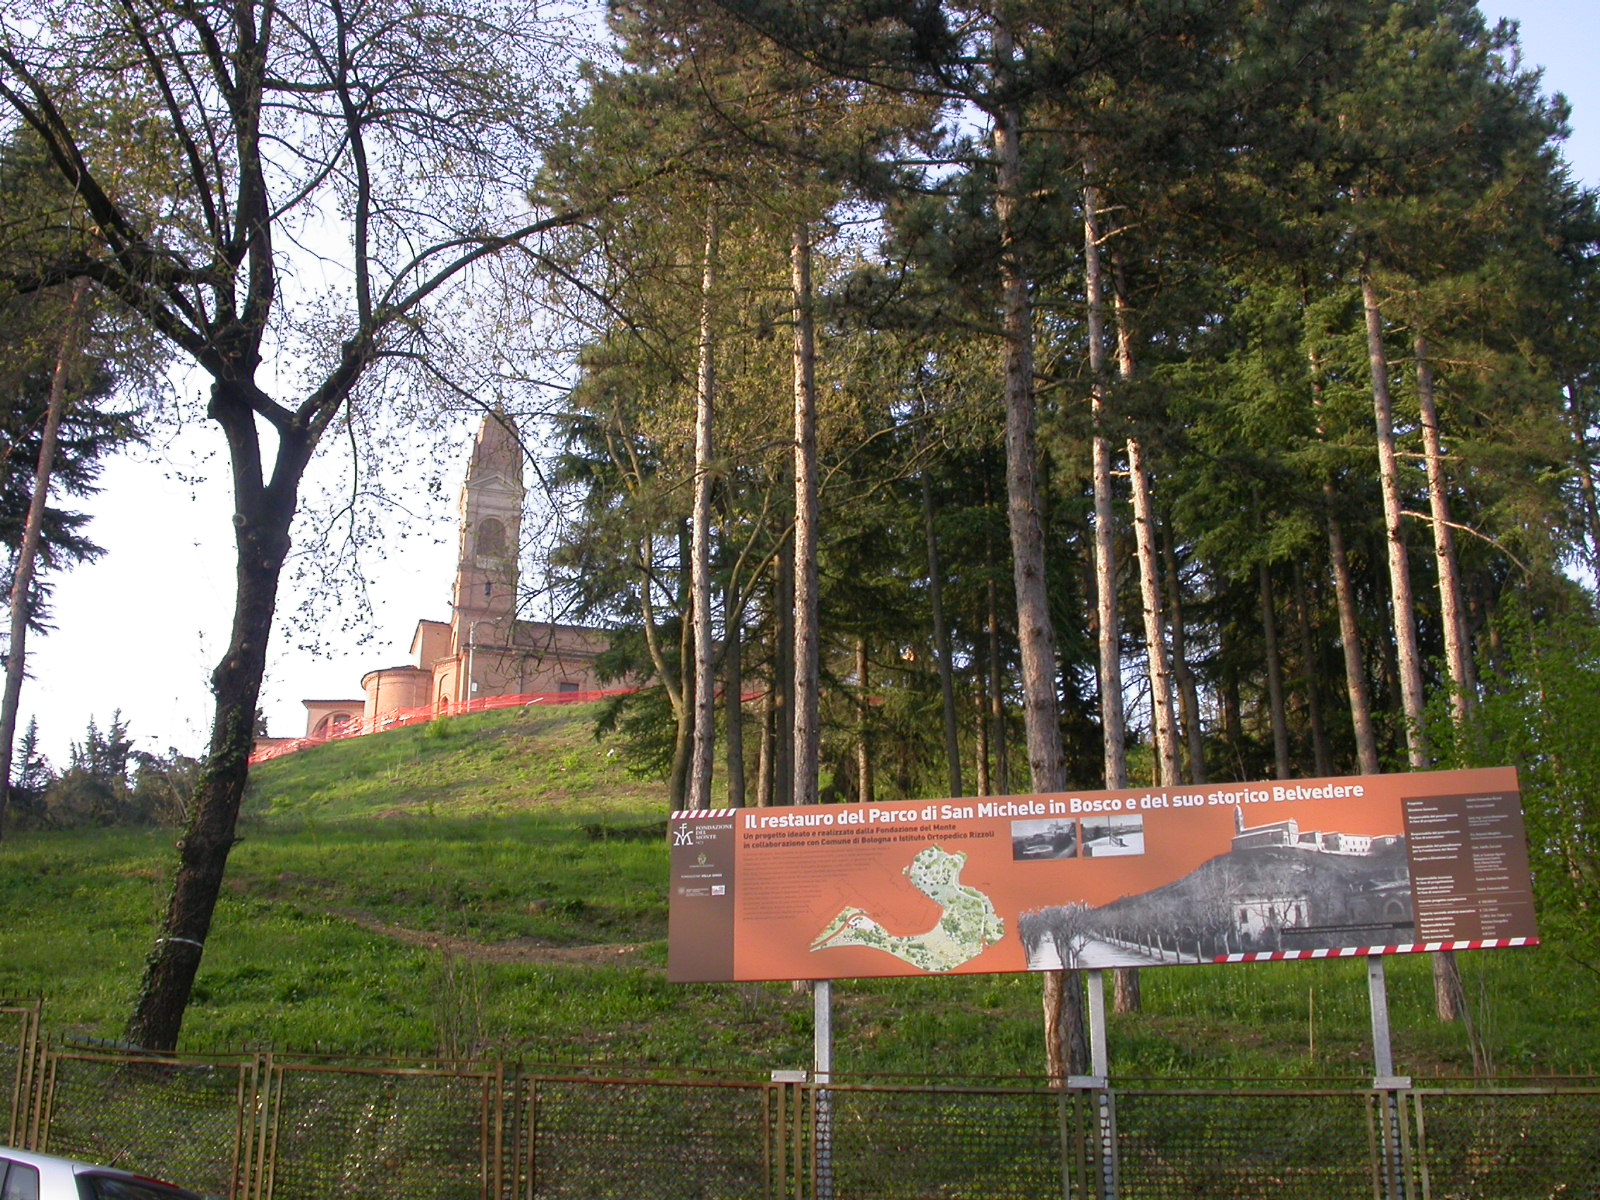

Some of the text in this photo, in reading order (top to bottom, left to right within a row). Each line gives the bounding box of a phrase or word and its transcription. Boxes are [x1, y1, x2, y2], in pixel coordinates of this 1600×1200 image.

[745, 783, 1364, 829] Il restauro del Parco di San Michele in Bosco e del suo storico Belvedere
[695, 823, 733, 831] FONDAZIONE
[743, 832, 754, 840] Un
[755, 832, 786, 841] progetto
[787, 830, 810, 838] ideato
[817, 828, 854, 837] realizzato
[855, 827, 874, 835] dalla
[876, 825, 918, 834] Fondazione
[933, 823, 957, 831] Monte
[743, 841, 750, 849] in
[751, 839, 805, 849] collaborazione
[820, 838, 851, 846] Comune
[861, 836, 892, 845] Bologna
[899, 834, 926, 842] Istituto
[927, 833, 968, 841] Ortopedico
[969, 831, 995, 839] Rizzoli
